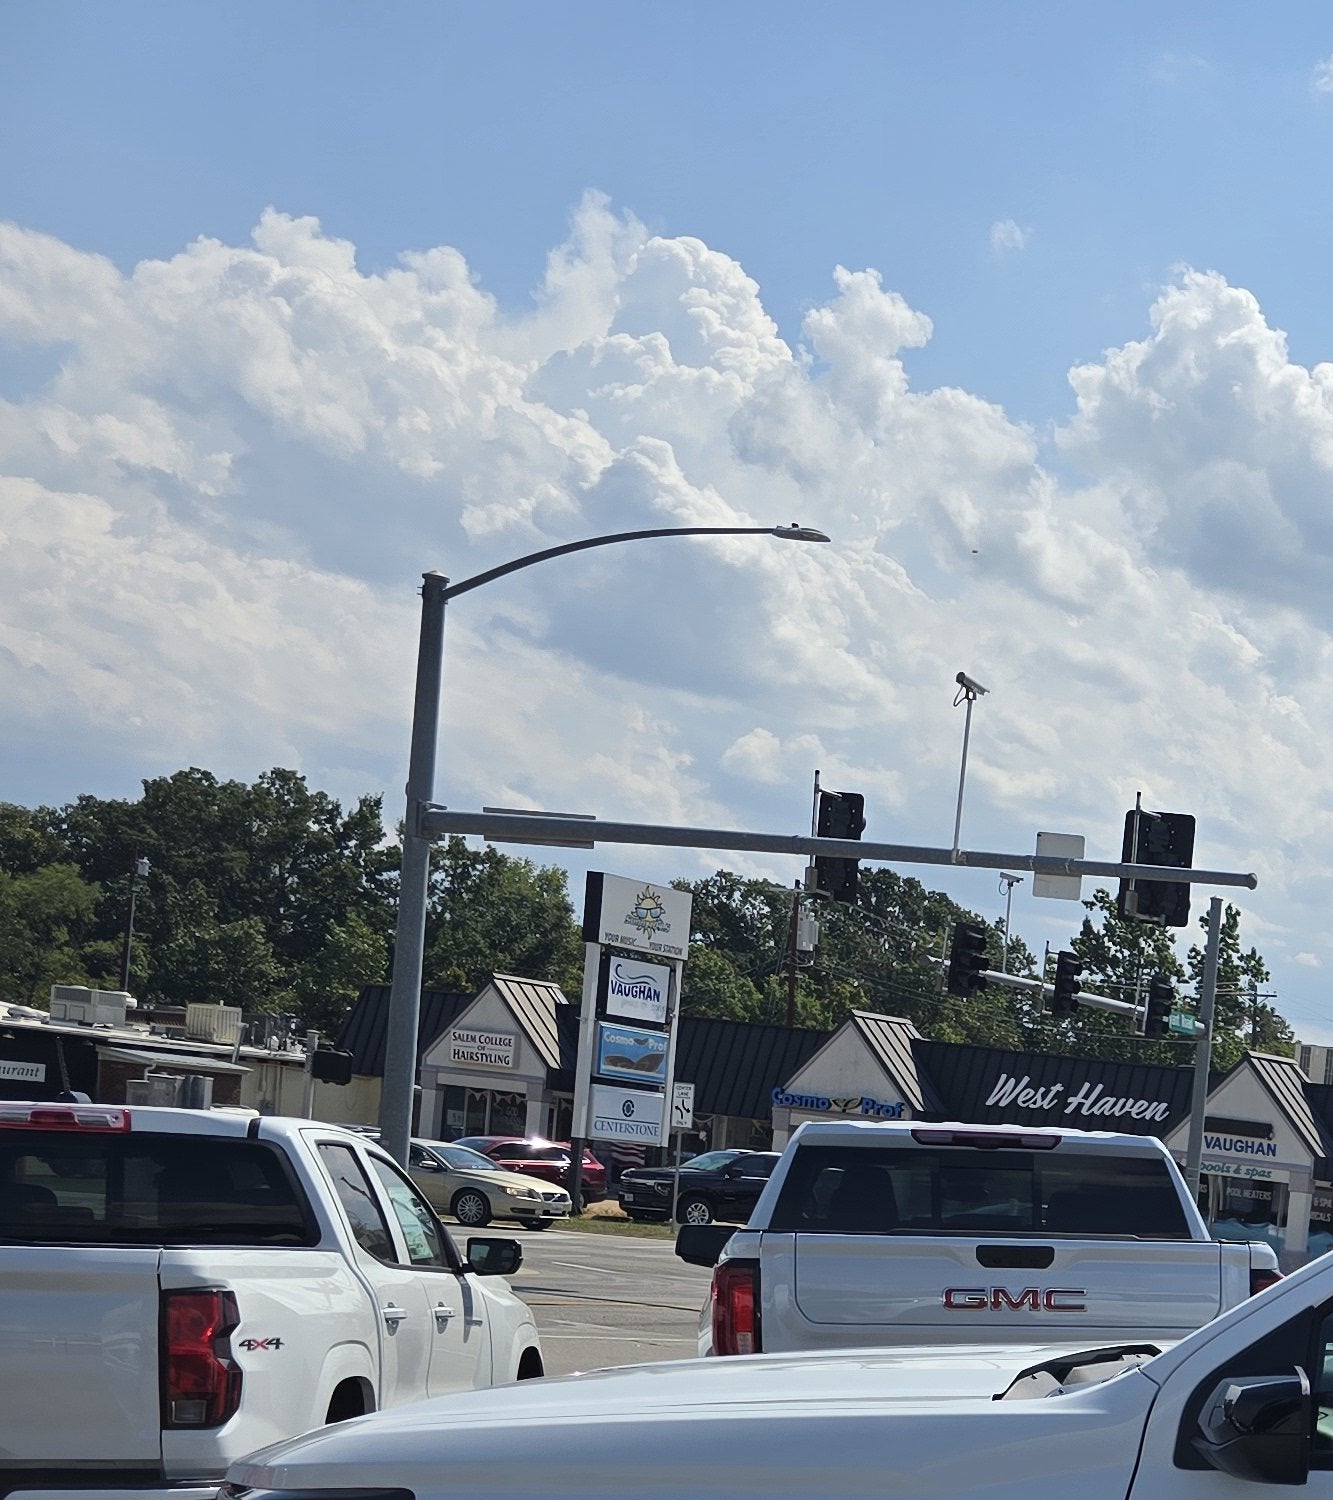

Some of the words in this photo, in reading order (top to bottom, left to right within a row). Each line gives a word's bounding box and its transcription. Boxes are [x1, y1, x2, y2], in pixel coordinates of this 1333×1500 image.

[604, 931, 619, 943] YOUR
[663, 943, 683, 956] STATION
[610, 980, 661, 1002] VAUGHAN
[452, 1031, 476, 1043] SALEM
[478, 1034, 512, 1047] COLLEGE
[604, 1031, 634, 1046] Cosmo
[453, 1048, 510, 1065] HAIRSTYLING
[771, 1087, 832, 1110] Cosmo
[861, 1097, 905, 1118] Prof
[985, 1073, 1064, 1110] West
[1063, 1081, 1170, 1122] Haven
[594, 1120, 660, 1137] CENTERSTONE
[1203, 1135, 1277, 1157] VAUGHAN
[1244, 1167, 1272, 1178] spas
[1226, 1186, 1242, 1197] POOL
[1243, 1189, 1272, 1200] HEATERS
[1320, 1199, 1332, 1208] SPA
[942, 1286, 1088, 1312] GMC
